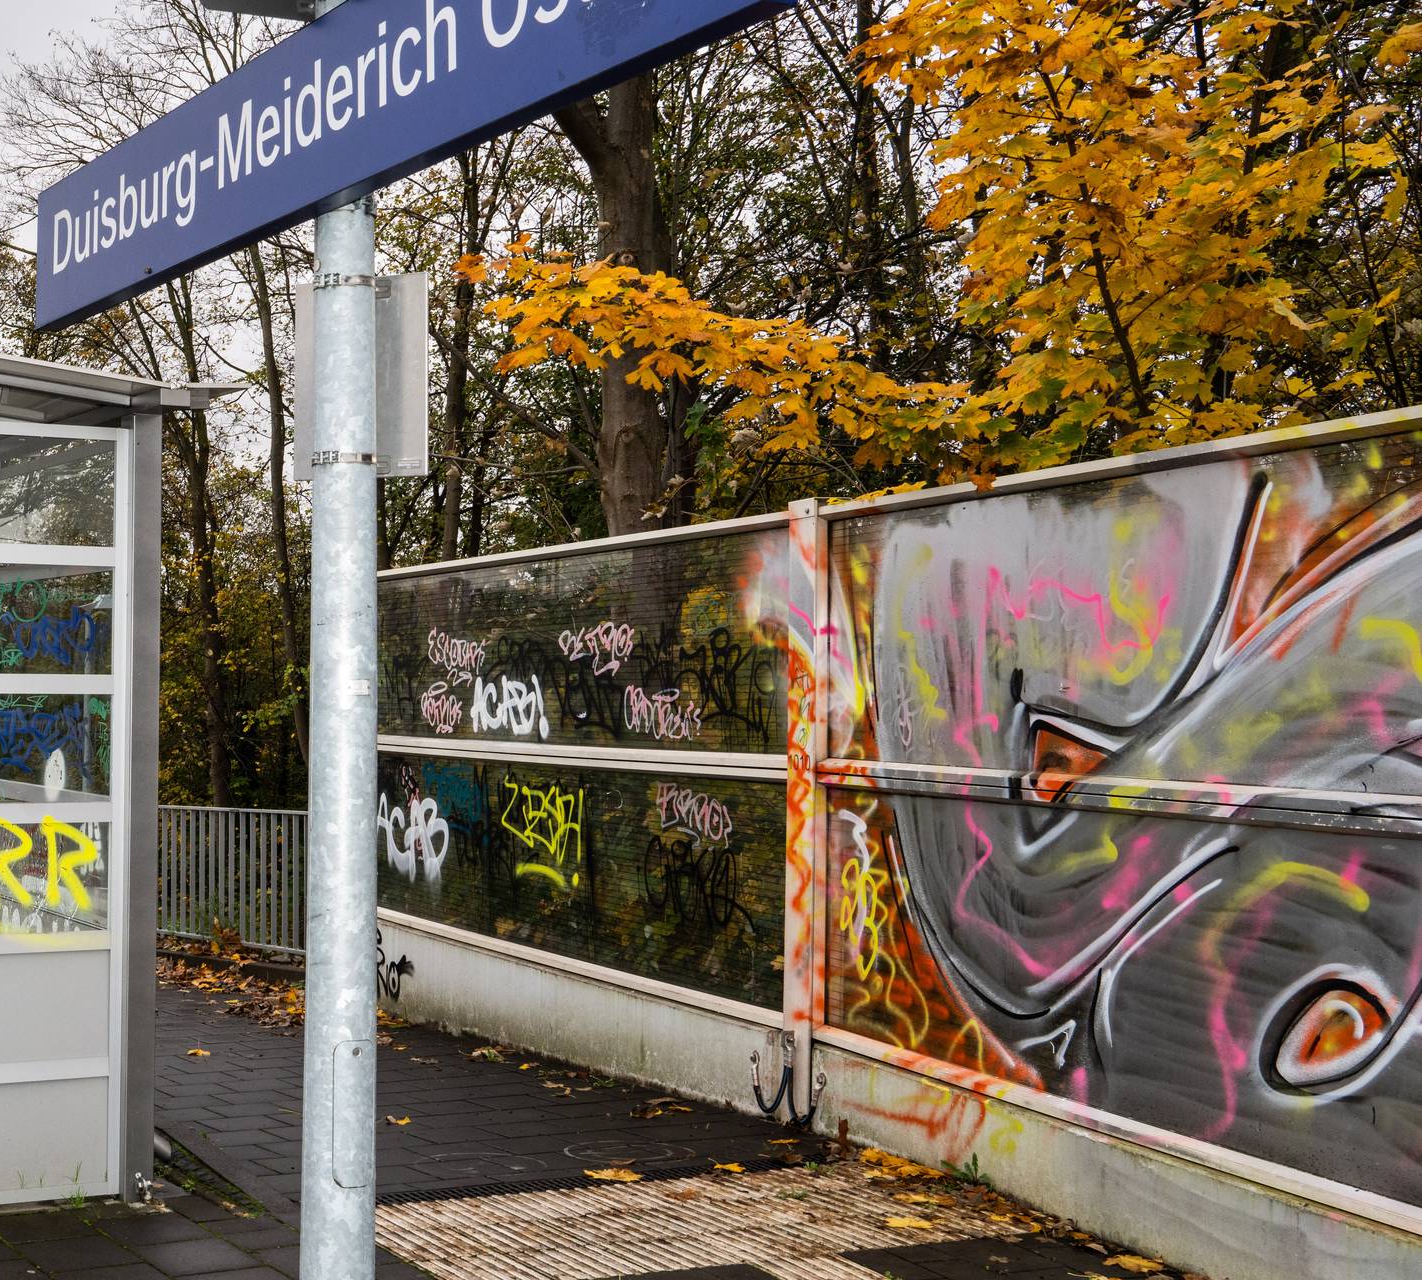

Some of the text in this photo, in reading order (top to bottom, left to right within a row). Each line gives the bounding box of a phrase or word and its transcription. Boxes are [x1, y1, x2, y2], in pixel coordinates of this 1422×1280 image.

[52, 0, 458, 276] Duisburg-Meiderich
[470, 674, 550, 740] ACAB!
[788, 753, 812, 771] 1010
